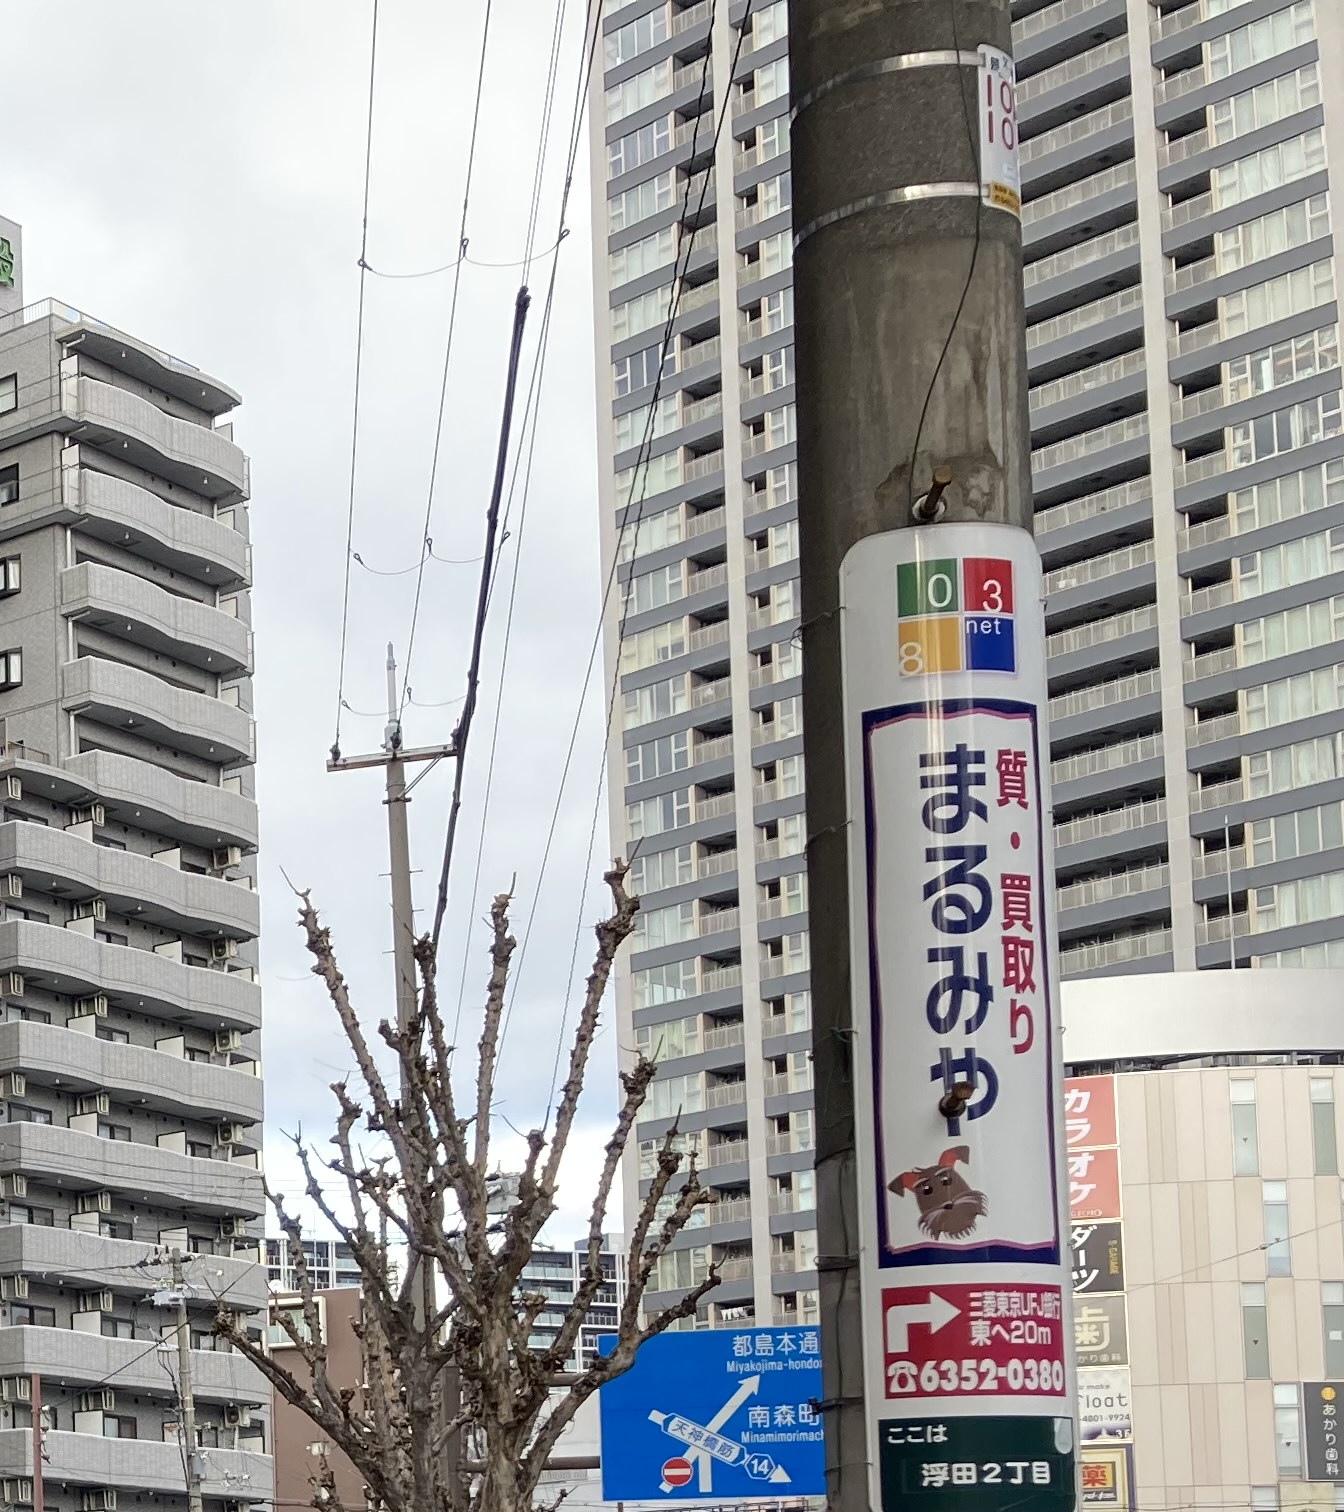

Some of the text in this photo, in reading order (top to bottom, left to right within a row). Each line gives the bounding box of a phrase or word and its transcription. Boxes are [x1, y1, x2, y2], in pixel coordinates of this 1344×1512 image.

[965, 617, 1002, 636] net
[994, 747, 1036, 1055] 質・買取り
[918, 742, 1000, 1137] まるみや
[1064, 1088, 1097, 1206] カラオケ
[1072, 1224, 1100, 1293] ダーツ
[968, 1291, 1061, 1320] 三菱東京UFJ銀行
[733, 1331, 820, 1357] 都島本通
[970, 1319, 1052, 1347] 東へ20m
[920, 1358, 1064, 1392] 6352-0380
[747, 1403, 820, 1429] 南森町
[670, 1418, 736, 1459] 天神橋筋
[887, 1424, 948, 1444] ここは
[1322, 1403, 1340, 1476] あかり歯科
[752, 1458, 769, 1475] 14
[921, 1461, 1052, 1488] 浮田2丁目
